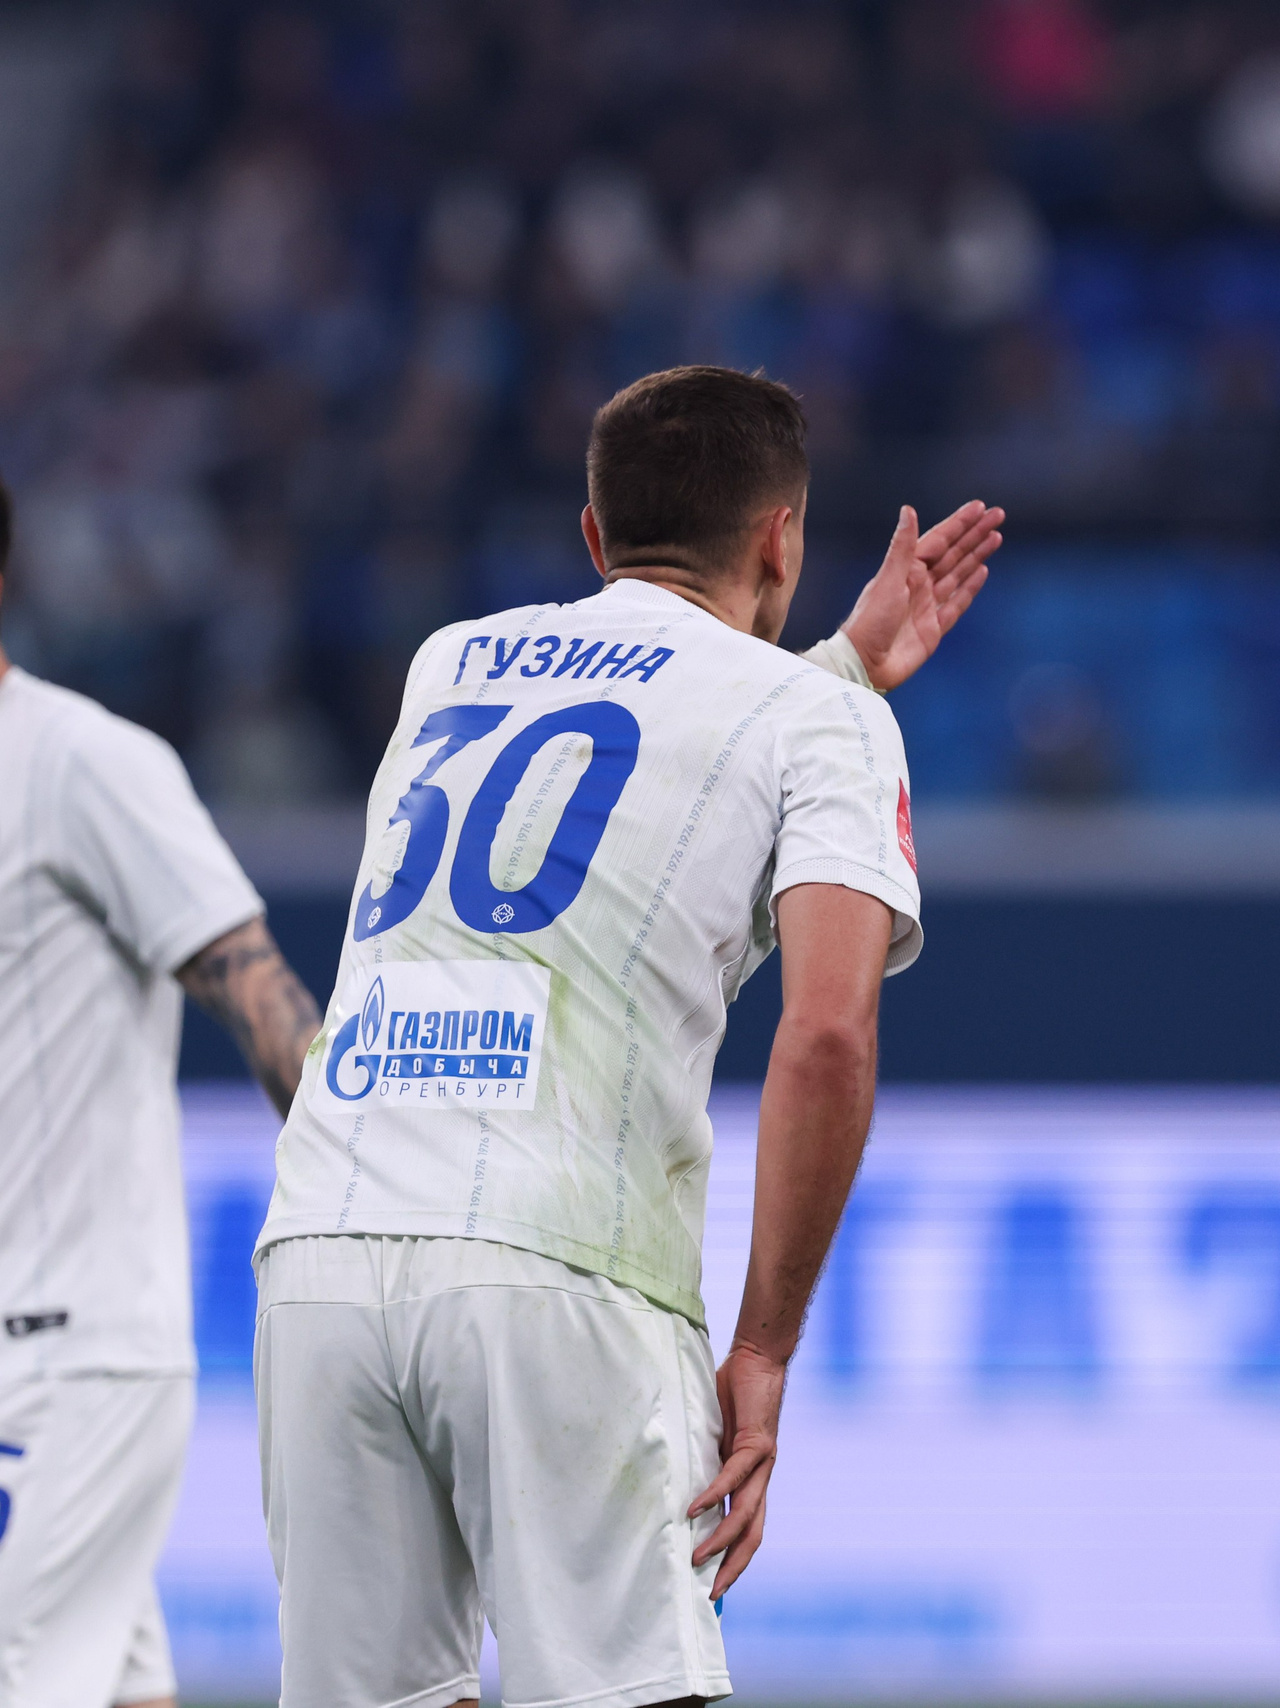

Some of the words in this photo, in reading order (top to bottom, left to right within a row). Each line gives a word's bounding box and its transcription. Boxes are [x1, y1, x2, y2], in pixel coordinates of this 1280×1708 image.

[453, 634, 676, 685] ГУЗИНА
[508, 846, 522, 868] 1976
[516, 822, 532, 843] 1976
[526, 799, 543, 818] 1976
[537, 779, 554, 796] 1976
[548, 759, 567, 776] 1976
[560, 738, 578, 756] 1976
[354, 700, 641, 942] 30
[621, 954, 637, 978] 1976
[631, 929, 648, 952] 1976
[643, 902, 660, 927] 1976
[654, 876, 670, 900] 1976
[666, 849, 684, 874] 1976
[677, 823, 695, 847] 1976
[688, 798, 706, 821] 1976
[700, 772, 719, 796] 1976
[713, 749, 731, 771] 1976
[726, 729, 744, 747] 1976
[737, 716, 756, 730] 1976
[752, 700, 771, 716] 1976
[767, 684, 788, 699] 1976
[387, 1010, 534, 1052] ГАЗПРОМ
[626, 1042, 639, 1065] 1976
[387, 1058, 522, 1077] ДОБЫЧА
[622, 1068, 634, 1091] 1976
[379, 1081, 526, 1099] ОРЕНБУРГ
[478, 1110, 490, 1134] 1976
[618, 1118, 631, 1143] 1976
[477, 1137, 490, 1156] 1976
[475, 1159, 487, 1182] 1976
[614, 1147, 624, 1171] 1976
[336, 1206, 350, 1229] 1976
[344, 1181, 357, 1203] 1976
[353, 1114, 365, 1135] 1976
[470, 1184, 483, 1207] 1976
[465, 1210, 478, 1234] 1976
[616, 1200, 625, 1222] 1976
[611, 1226, 623, 1250] 1976
[607, 1254, 618, 1276] 1976
